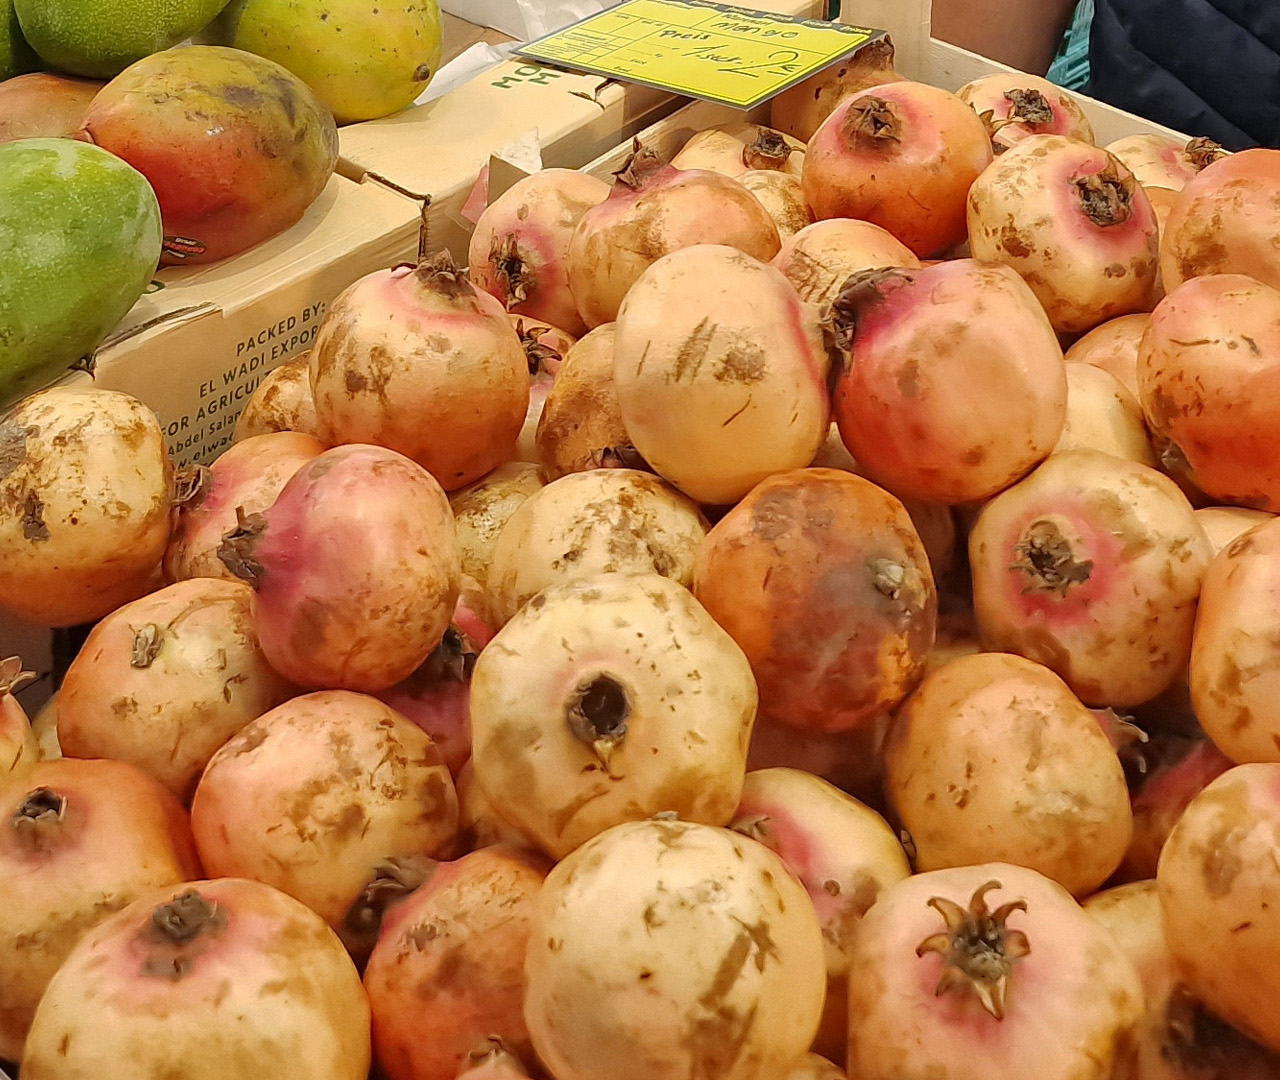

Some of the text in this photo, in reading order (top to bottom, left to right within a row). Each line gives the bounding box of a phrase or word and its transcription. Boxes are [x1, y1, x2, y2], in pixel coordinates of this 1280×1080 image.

[659, 29, 712, 40] Preis
[711, 21, 799, 38] Mango
[236, 301, 326, 357] PACKED BY:
[196, 369, 272, 422] AGRICUL
[199, 379, 217, 399] EL
[223, 352, 265, 385] WADI
